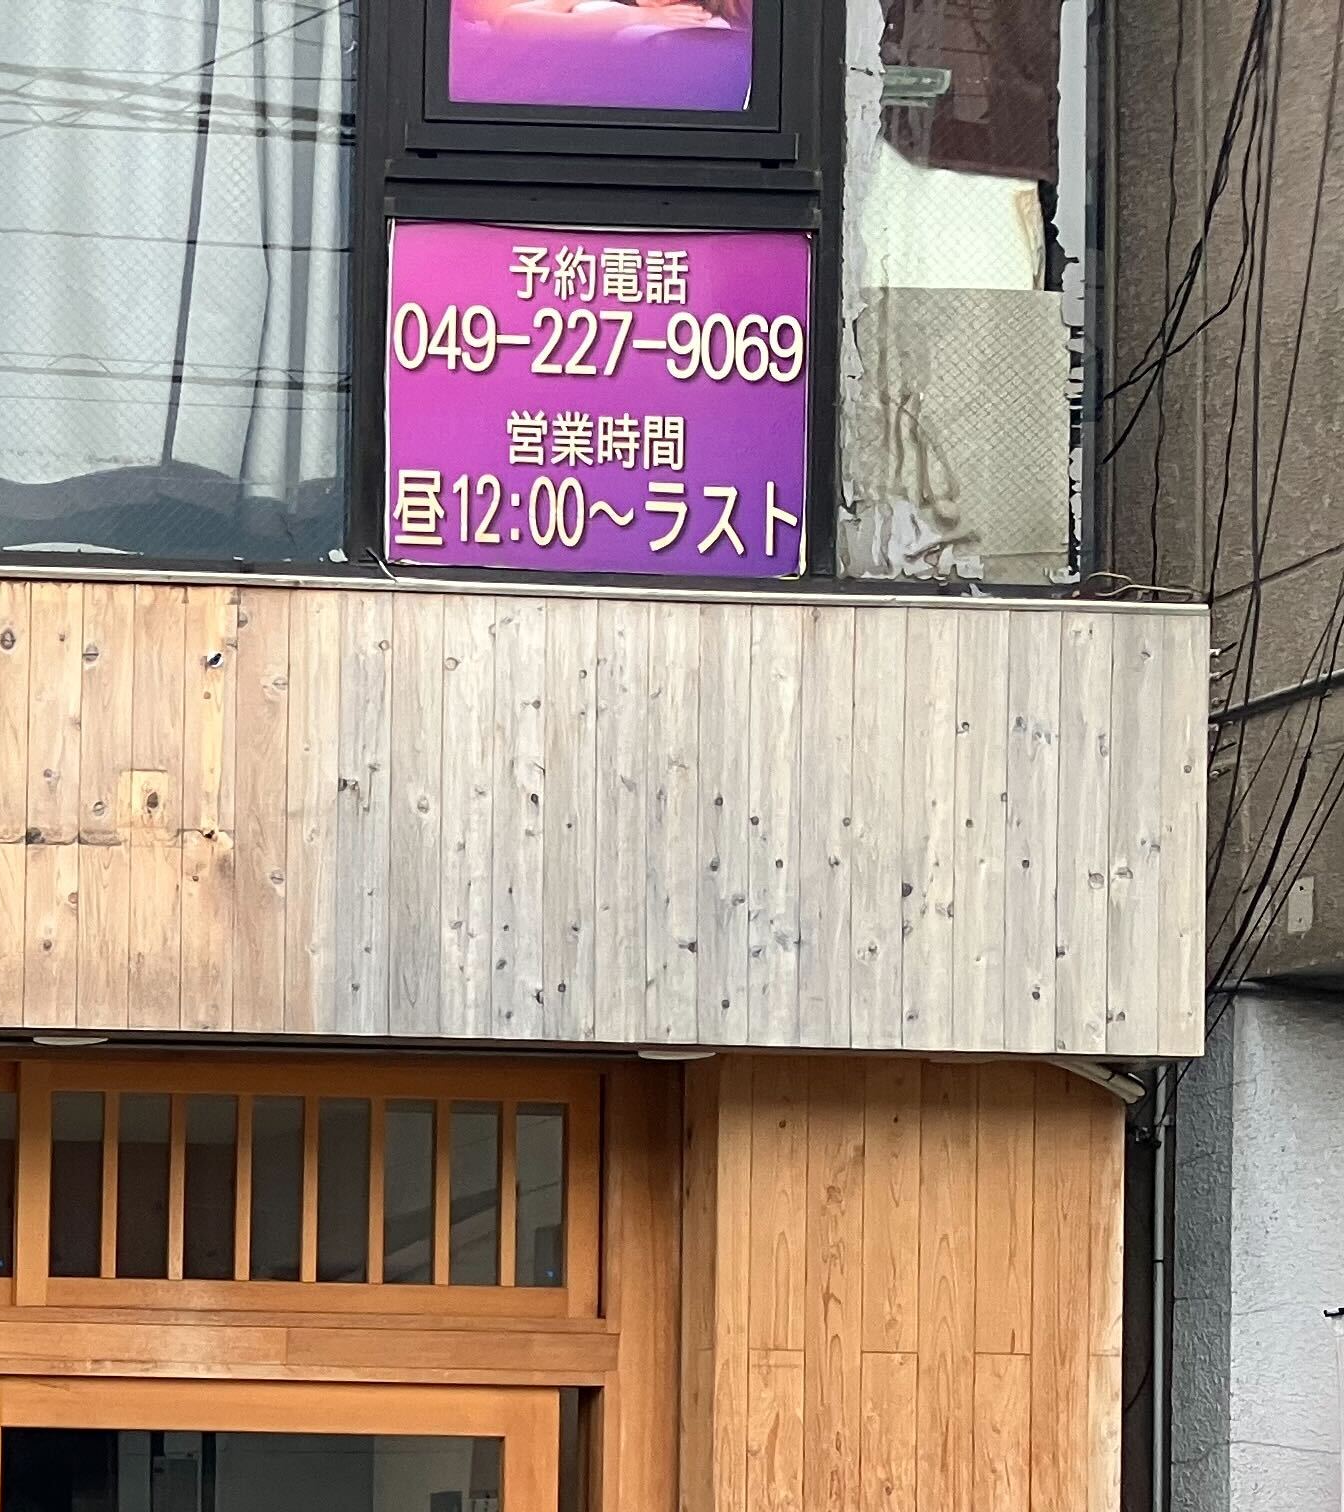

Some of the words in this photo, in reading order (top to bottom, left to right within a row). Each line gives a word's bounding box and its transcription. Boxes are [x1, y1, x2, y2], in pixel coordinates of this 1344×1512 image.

[509, 245, 689, 304] 予約電話
[394, 302, 803, 383] 049-227-9069
[507, 410, 685, 471] 営業時間
